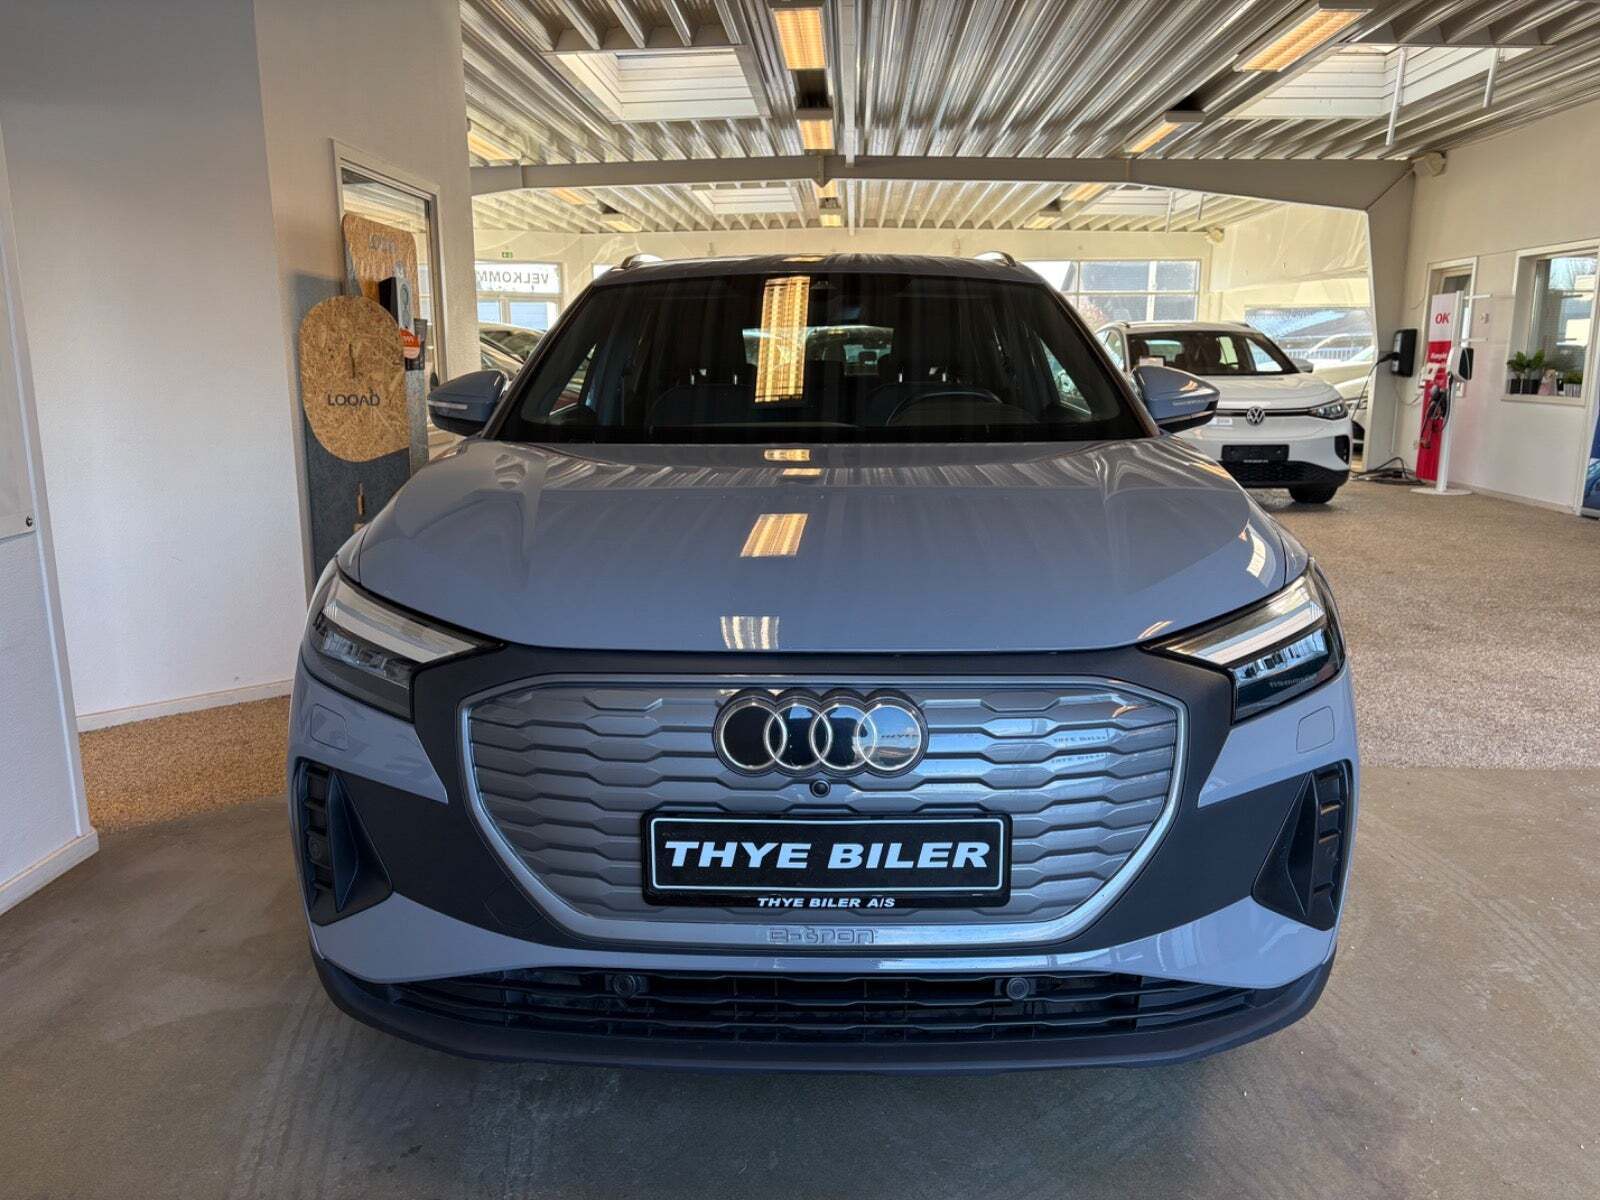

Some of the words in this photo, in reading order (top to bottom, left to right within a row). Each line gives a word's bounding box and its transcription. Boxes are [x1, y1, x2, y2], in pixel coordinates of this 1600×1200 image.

[1435, 312, 1451, 325] OK
[664, 840, 812, 869] THYE
[827, 842, 990, 869] BILER
[757, 897, 805, 908] THYE
[809, 898, 861, 908] BILER
[866, 898, 896, 908] A/S
[769, 926, 876, 945] e-tron
